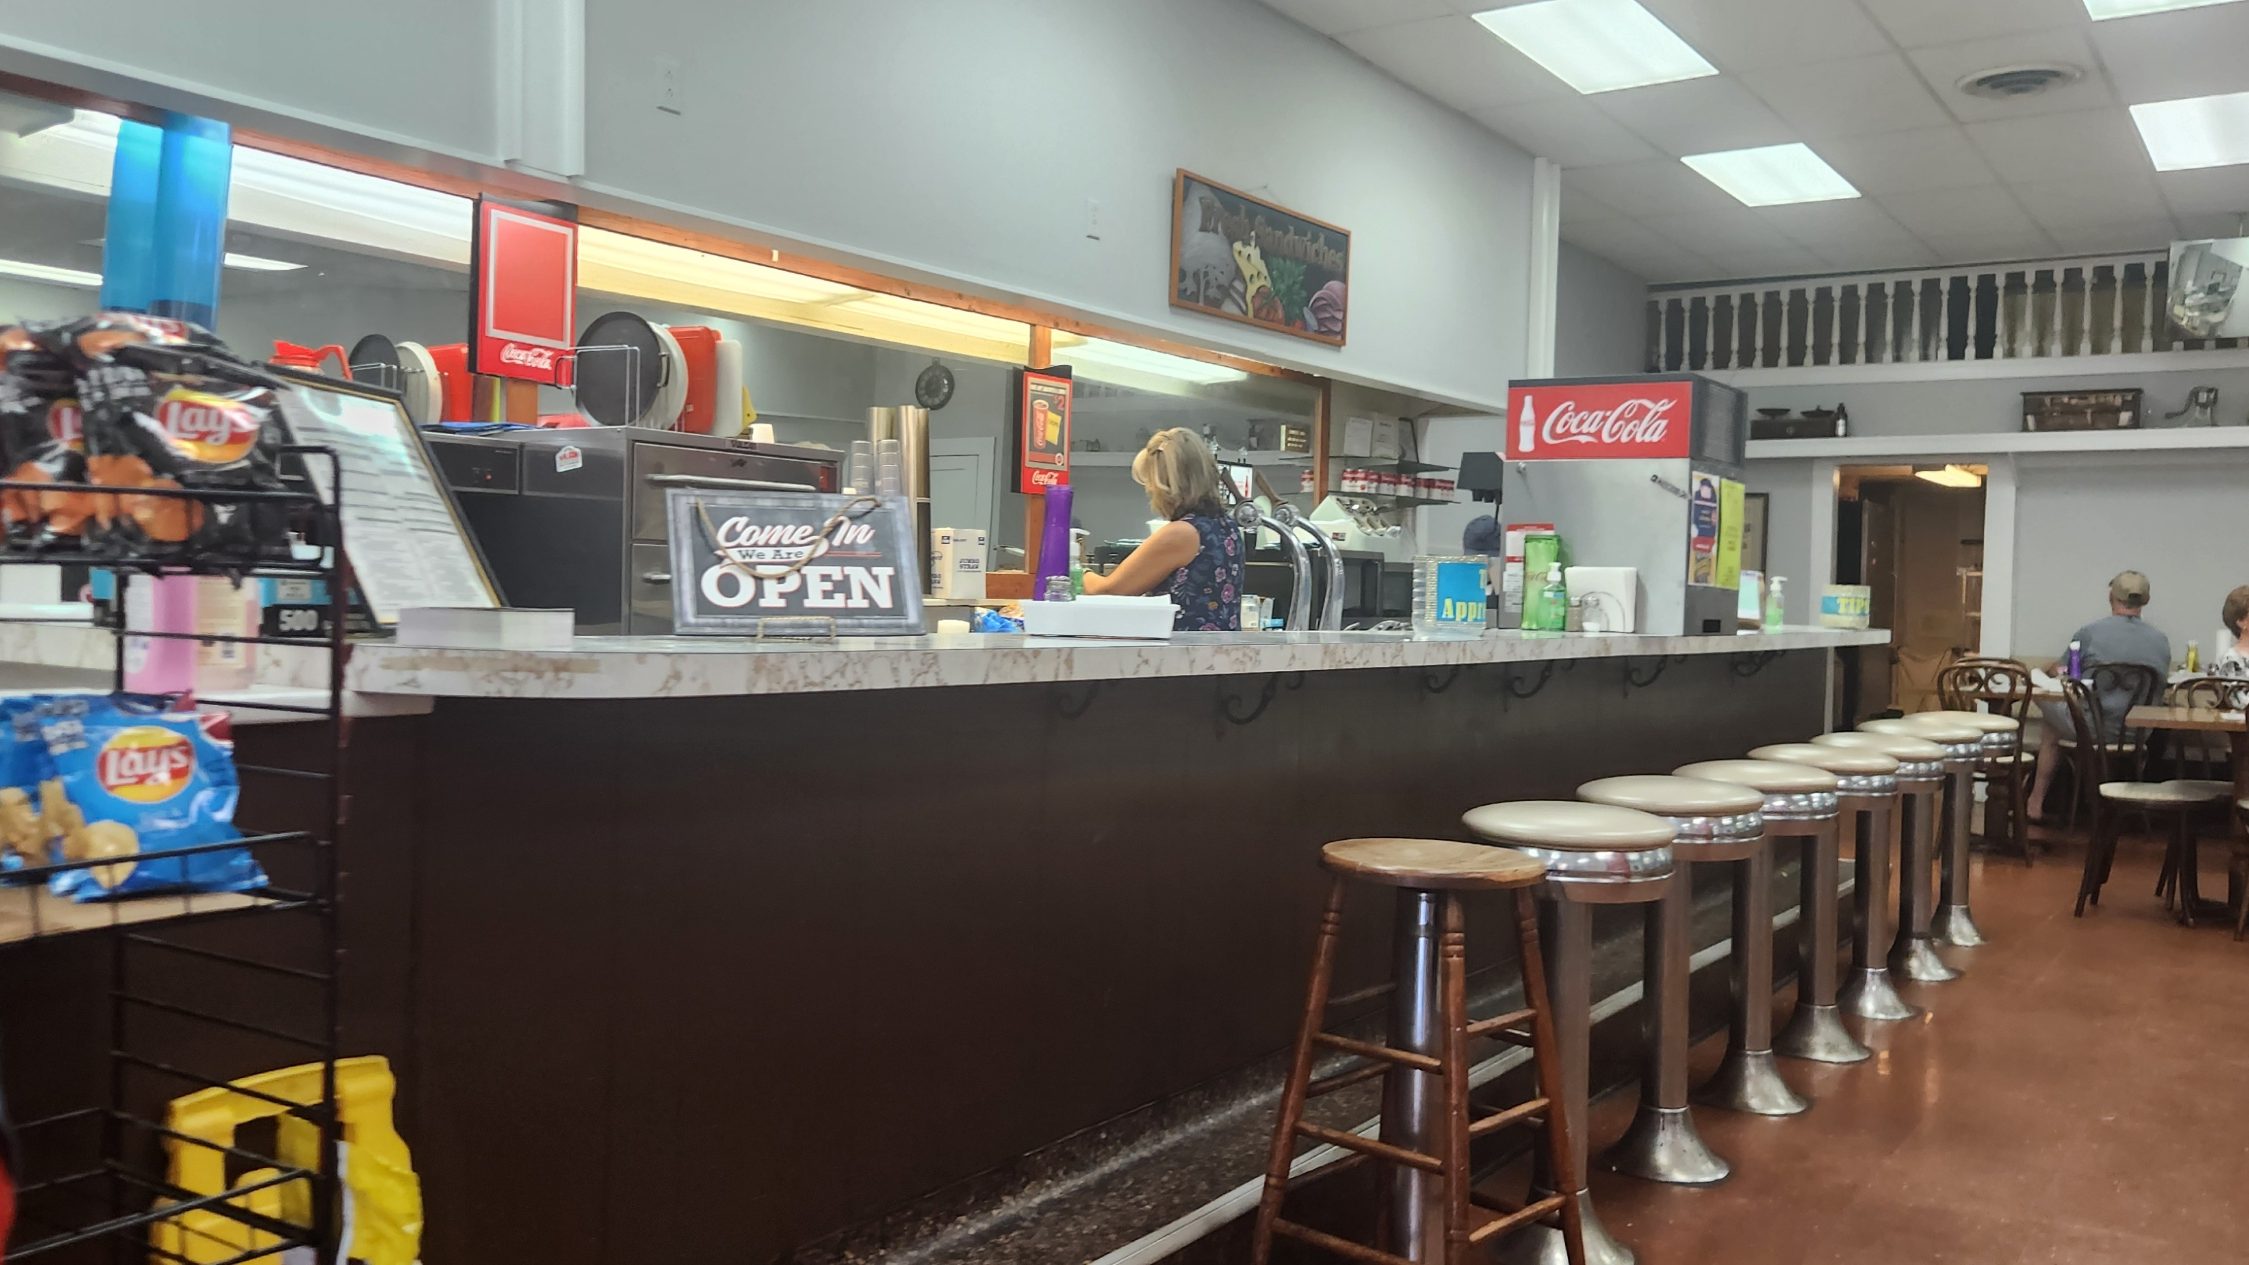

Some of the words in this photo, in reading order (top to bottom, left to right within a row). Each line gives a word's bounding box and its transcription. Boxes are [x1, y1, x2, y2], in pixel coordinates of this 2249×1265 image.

[500, 342, 555, 371] Coca-Cola
[1542, 399, 1679, 445] Coca-Cola
[716, 516, 814, 548] Come
[822, 515, 876, 547] In
[738, 549, 767, 560] We
[771, 549, 804, 560] Are
[701, 564, 895, 609] OPEN
[278, 609, 319, 632] 500
